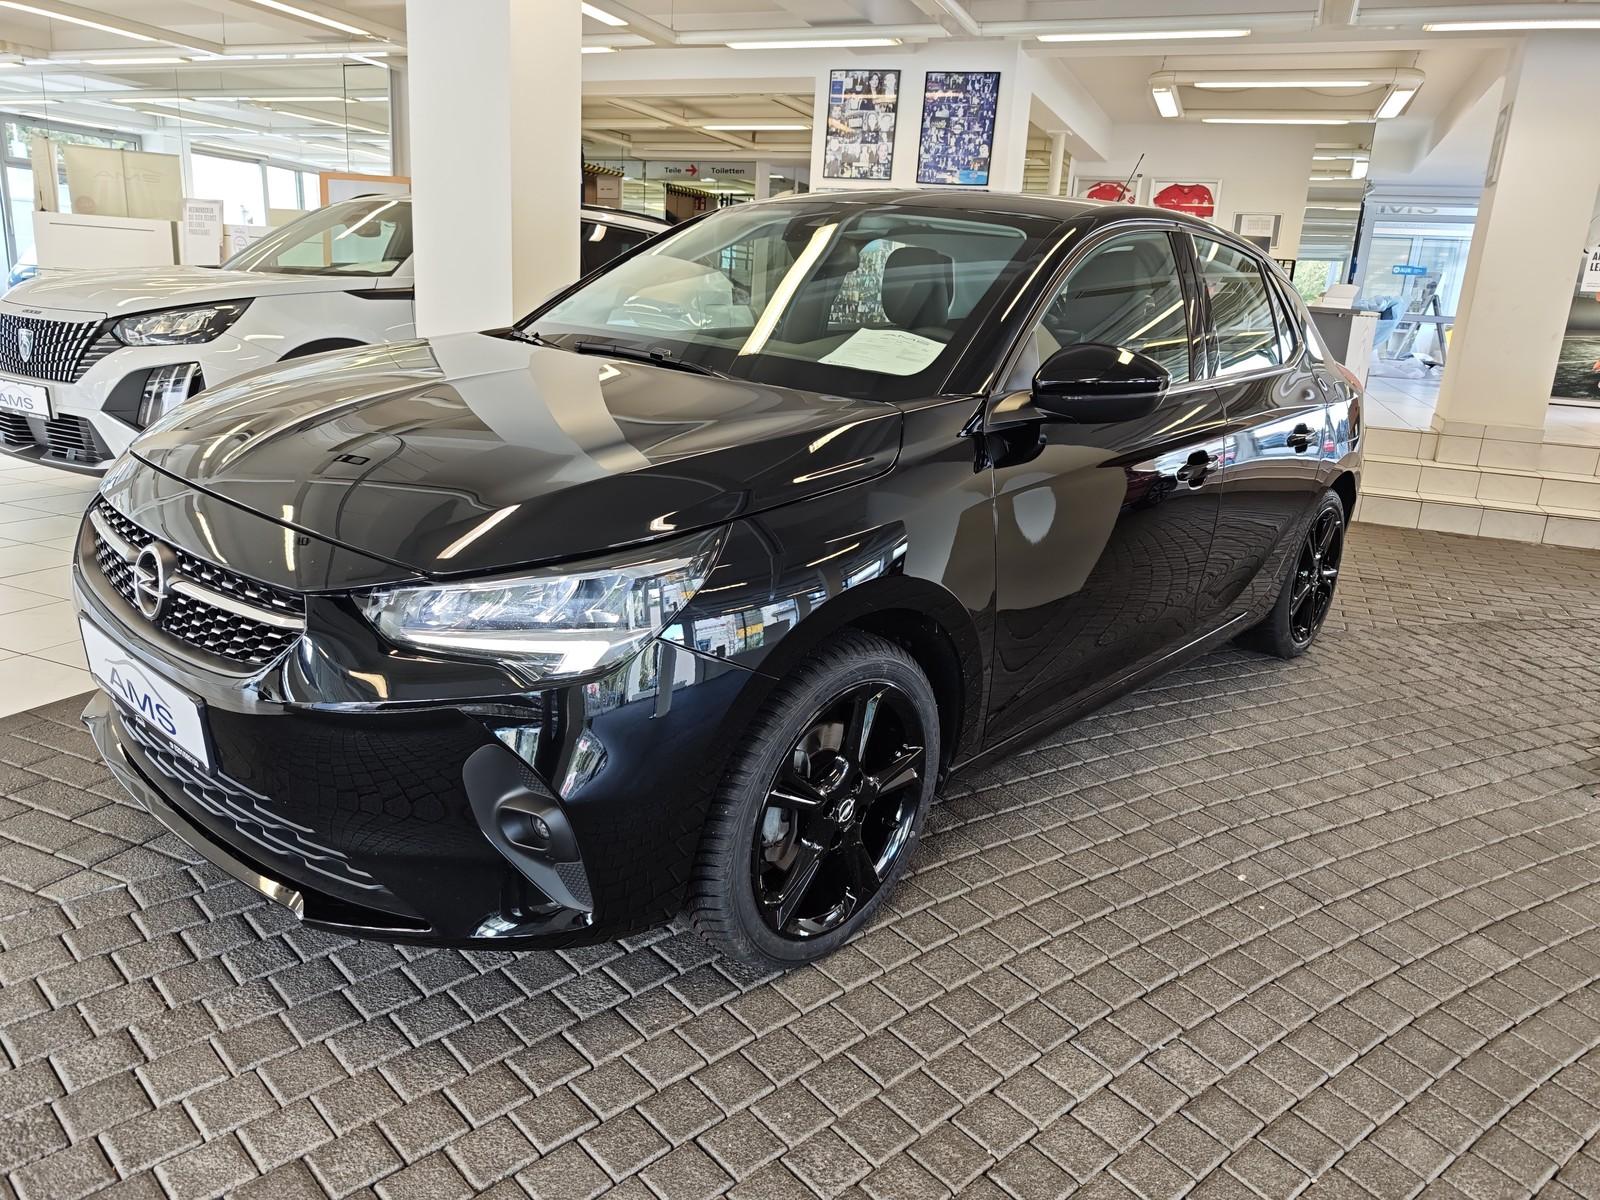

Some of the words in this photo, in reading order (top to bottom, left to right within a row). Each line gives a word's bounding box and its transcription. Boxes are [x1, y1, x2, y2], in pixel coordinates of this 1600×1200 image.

[664, 166, 682, 174] Teile
[711, 167, 745, 175] Toiletten
[0, 392, 34, 411] AMS
[110, 666, 178, 736] AMS
